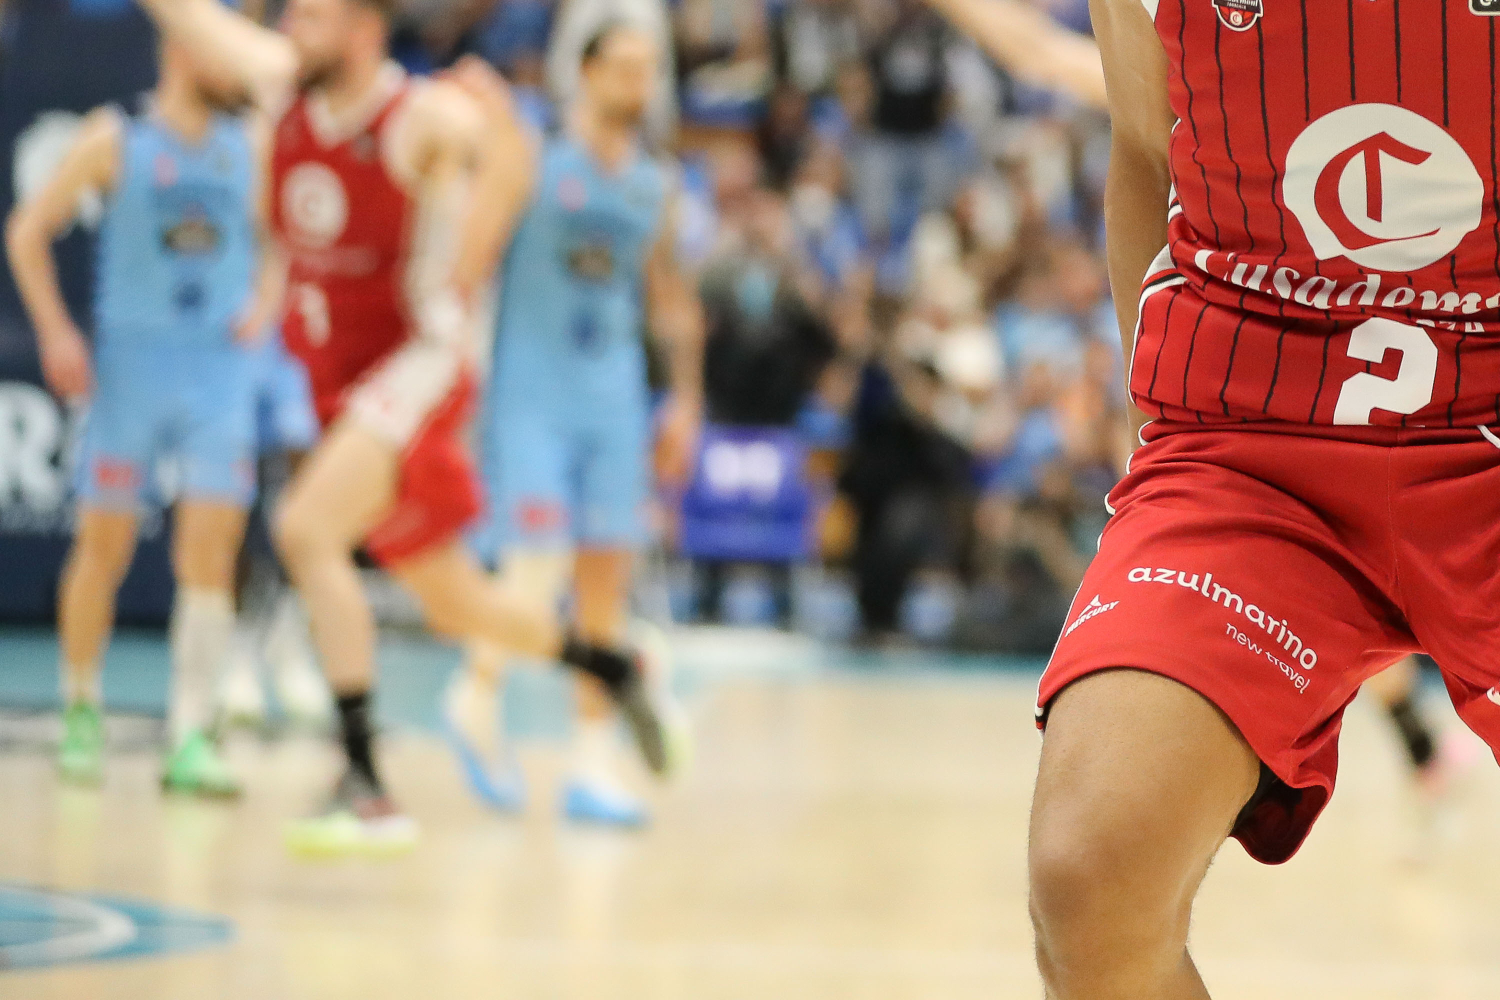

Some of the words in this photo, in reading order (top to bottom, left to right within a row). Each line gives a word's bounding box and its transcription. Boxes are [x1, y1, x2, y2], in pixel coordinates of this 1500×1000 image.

[1333, 317, 1438, 426] 2
[1064, 600, 1120, 638] MERCURY
[1127, 567, 1318, 670] azulmarino
[1226, 622, 1263, 655] new
[1265, 651, 1311, 694] travel
